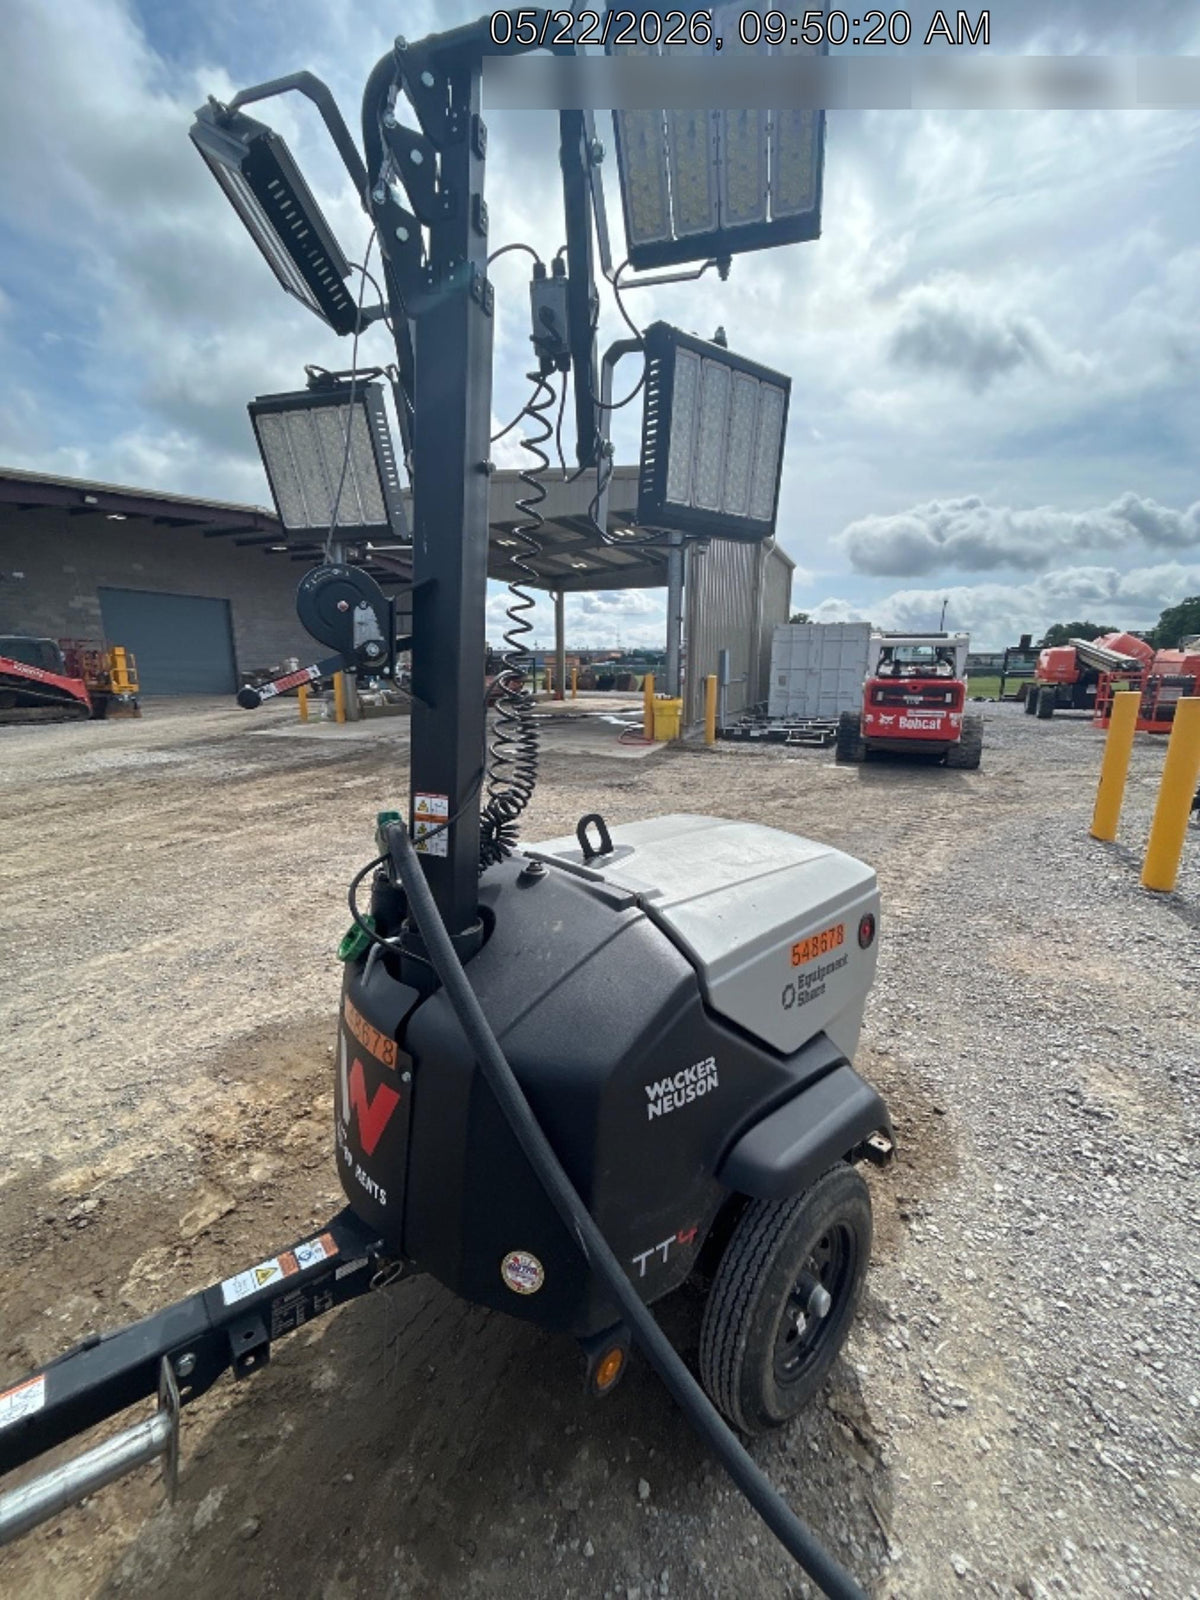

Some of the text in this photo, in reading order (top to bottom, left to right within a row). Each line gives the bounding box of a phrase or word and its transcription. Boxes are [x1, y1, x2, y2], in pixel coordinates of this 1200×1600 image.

[899, 716, 942, 730] Bobcat
[645, 1056, 717, 1101] WACKER
[647, 1071, 719, 1121] NEUSON
